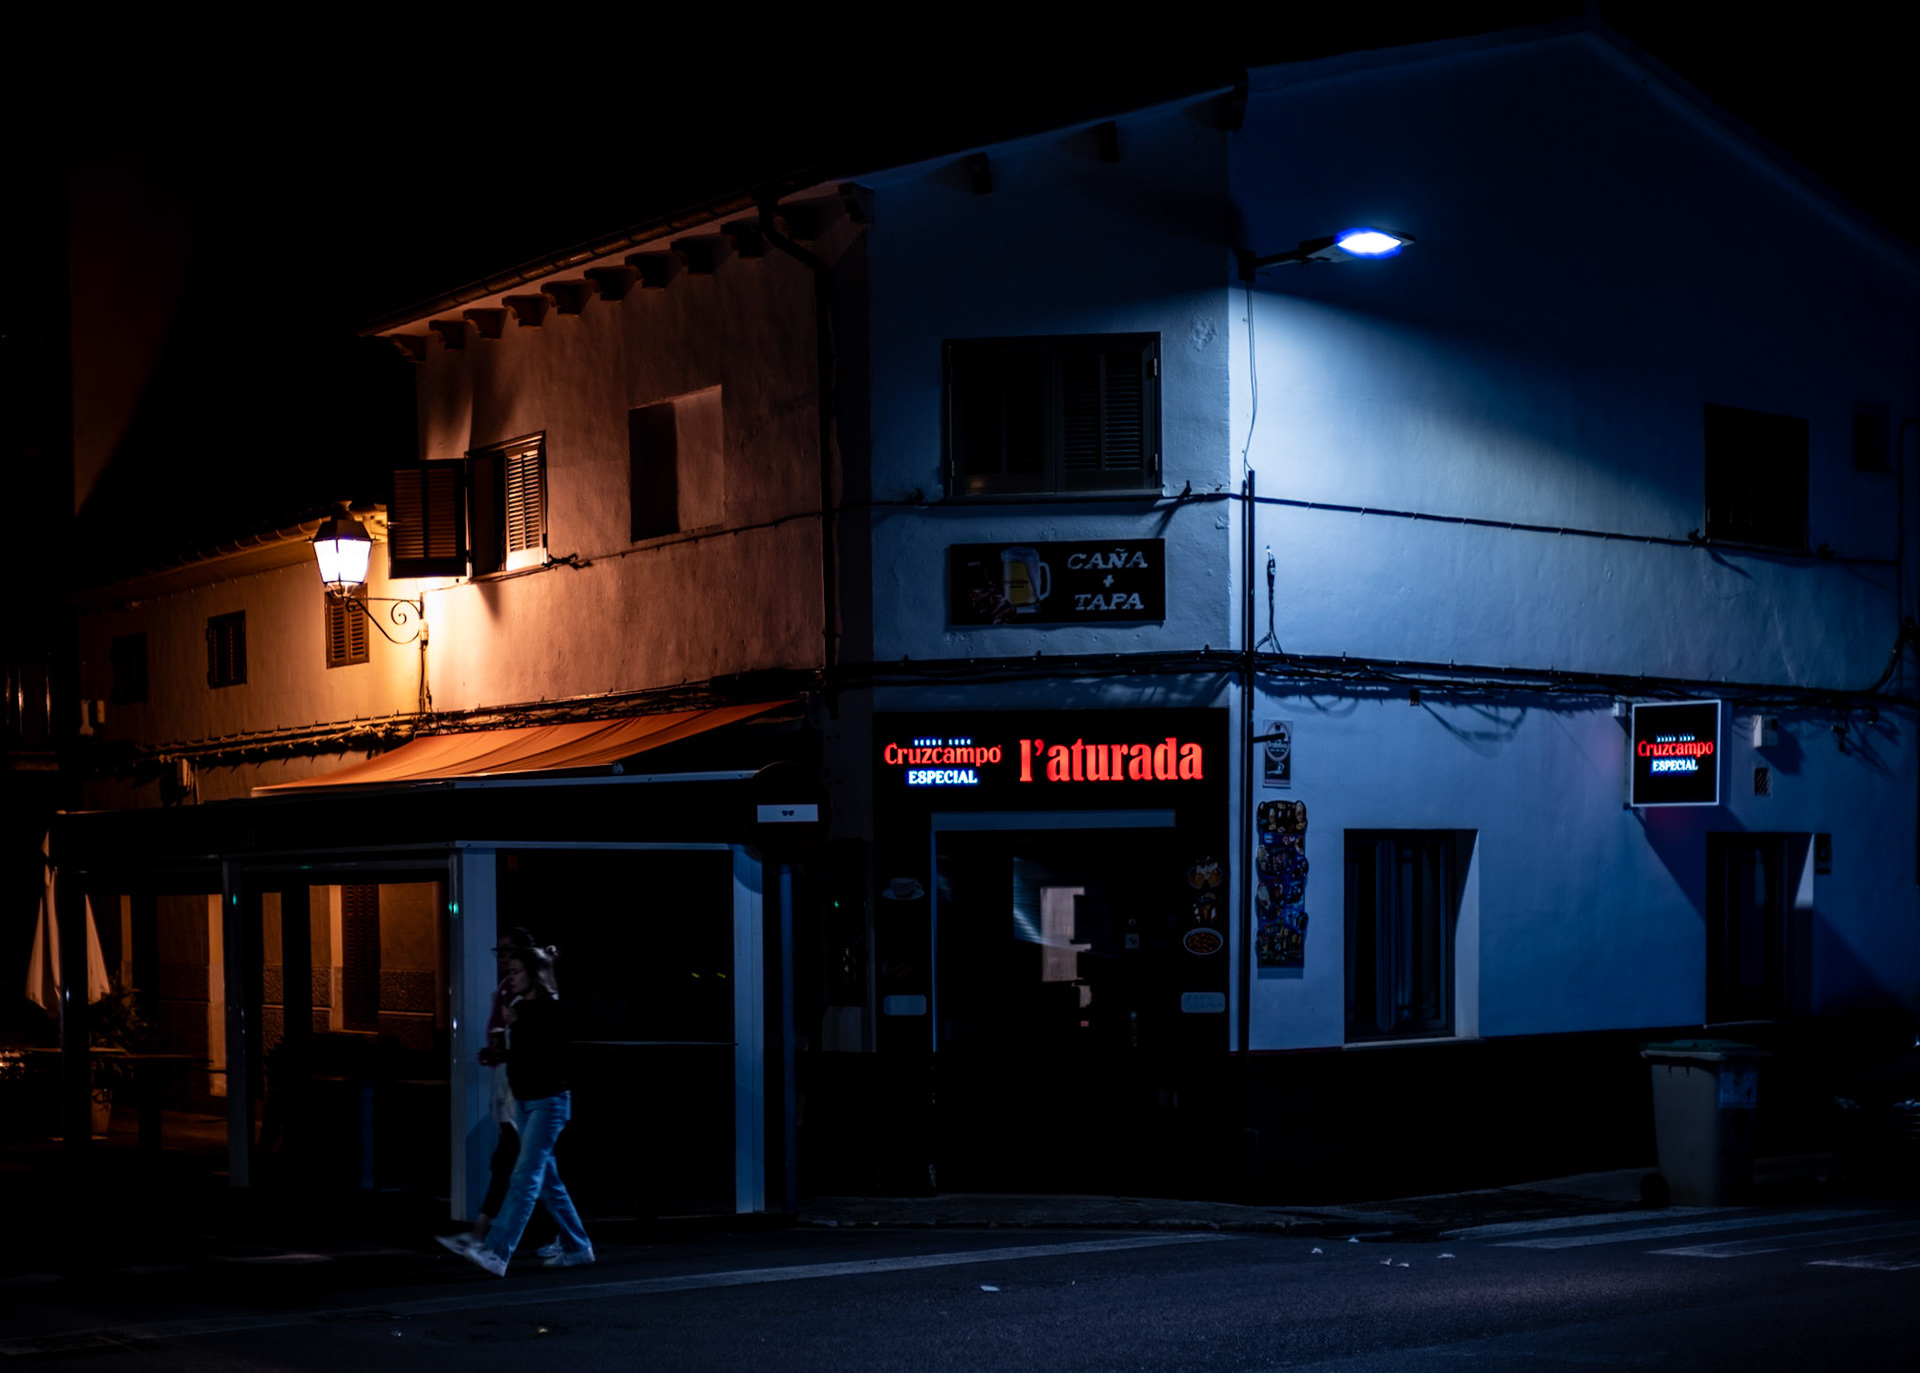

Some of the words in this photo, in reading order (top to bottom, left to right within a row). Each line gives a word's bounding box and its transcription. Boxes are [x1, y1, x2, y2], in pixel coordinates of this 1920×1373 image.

[1067, 548, 1148, 569] CAÑA
[1074, 592, 1145, 611] TAPA
[884, 742, 1002, 767] Cruzcampo
[1637, 740, 1714, 758] Cruzcampo
[1652, 758, 1699, 772] ESPECIAL
[908, 770, 978, 784] ESPECIAL
